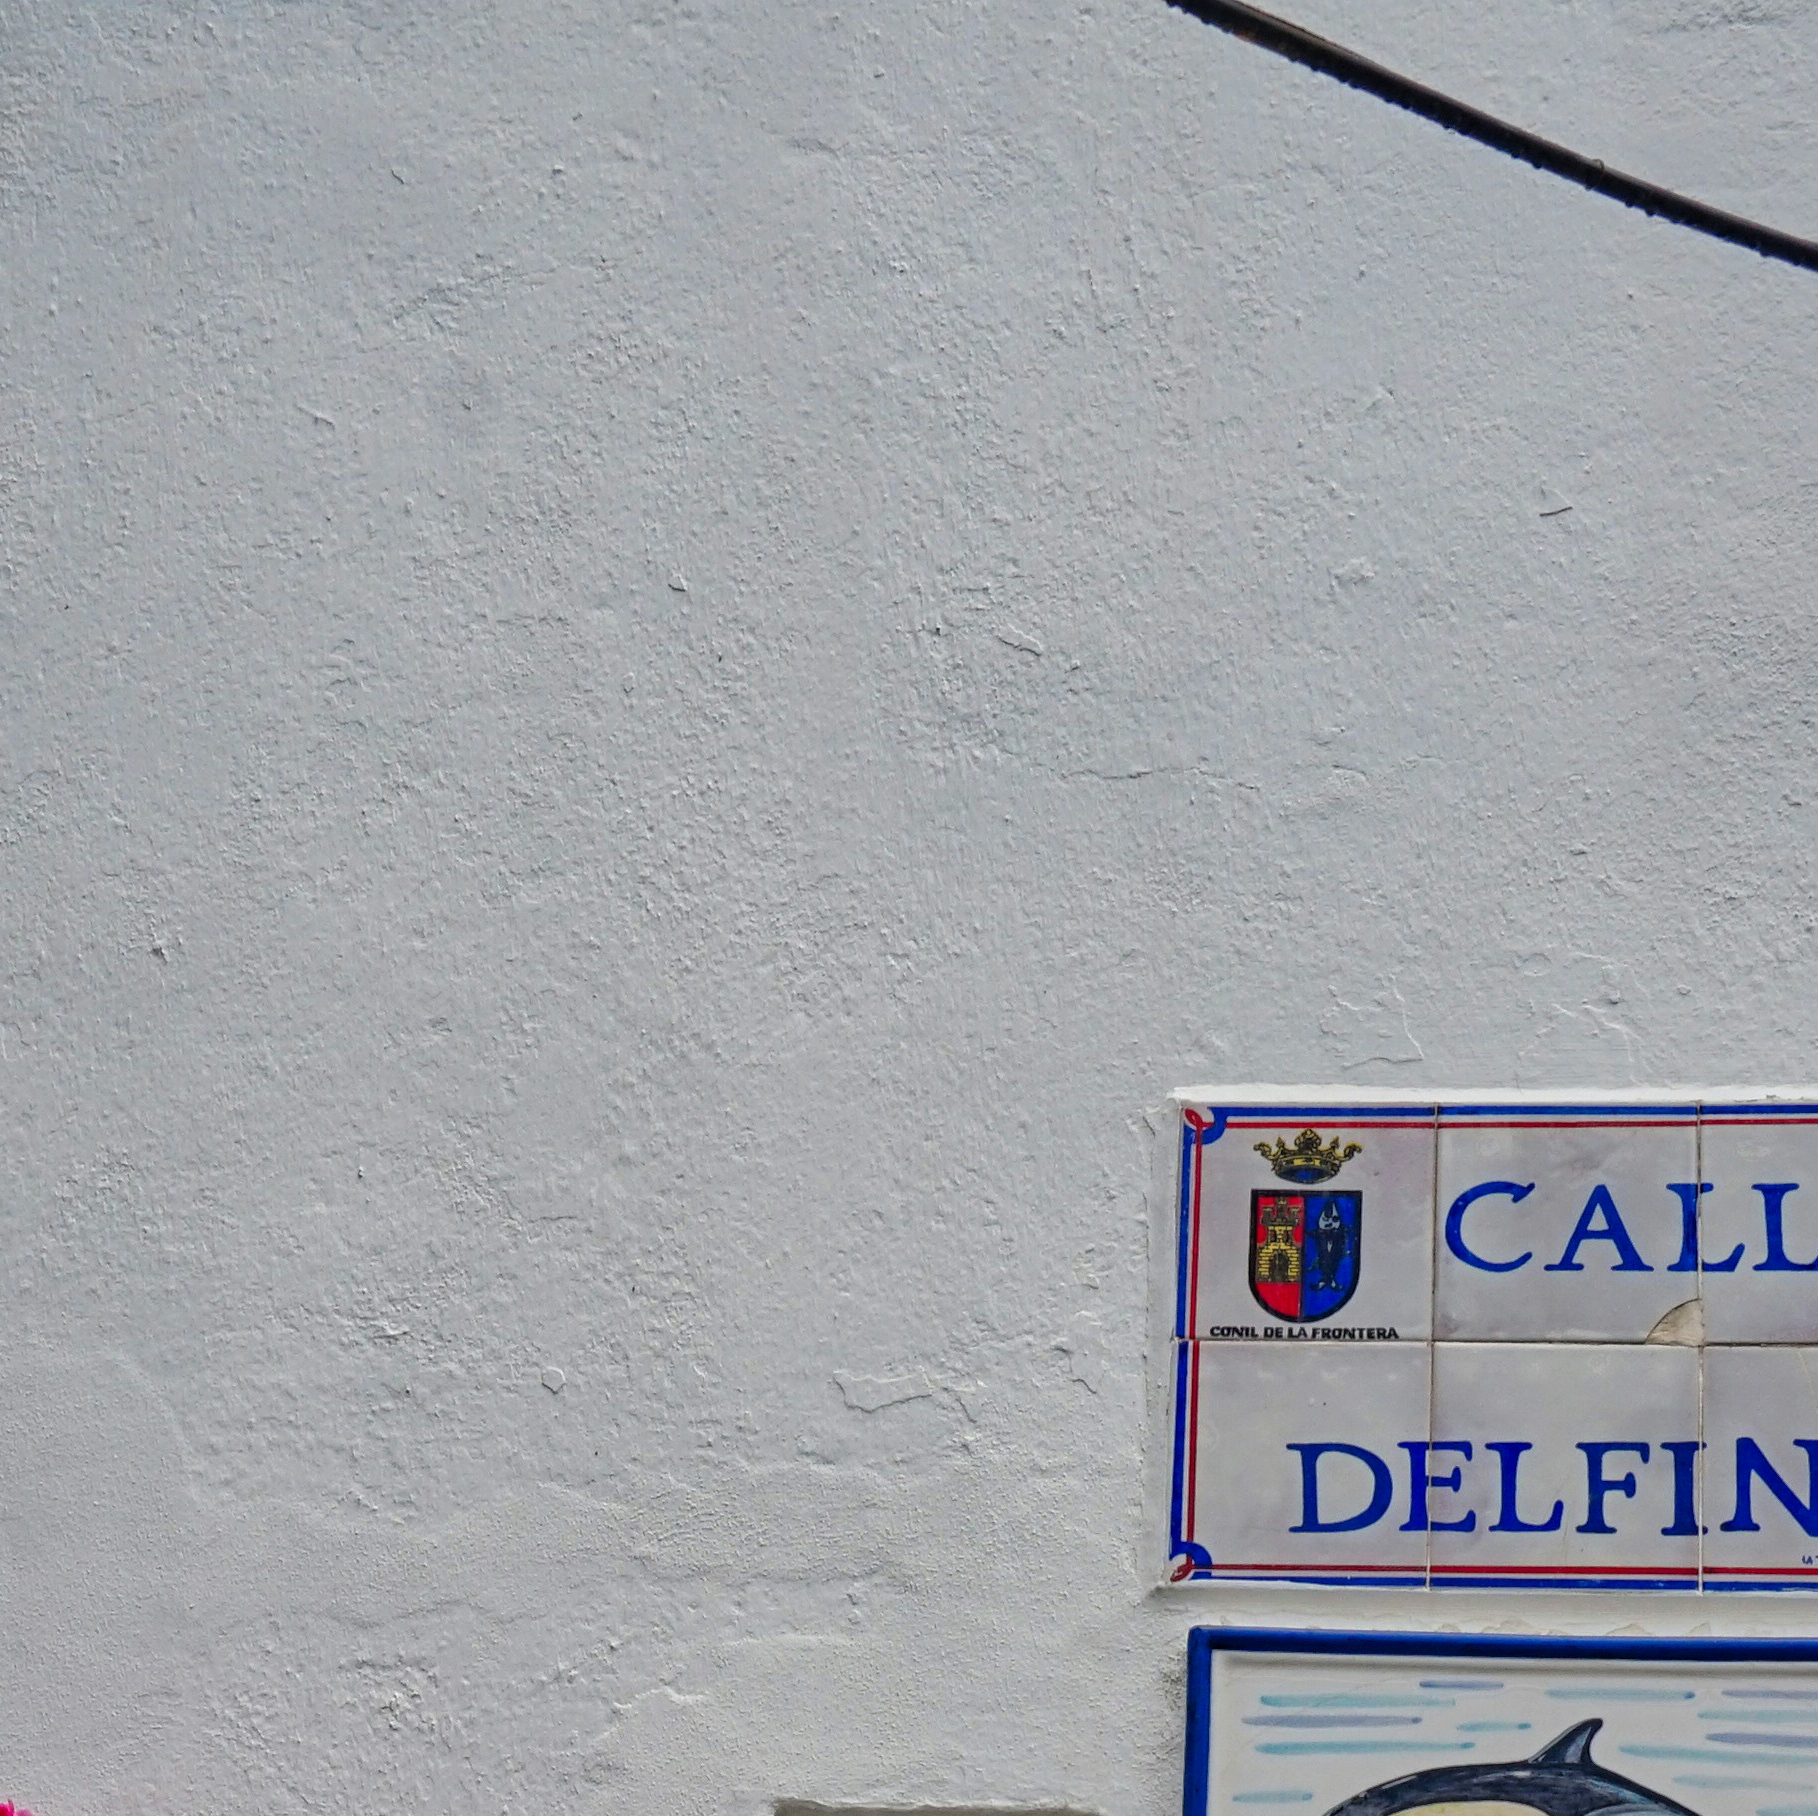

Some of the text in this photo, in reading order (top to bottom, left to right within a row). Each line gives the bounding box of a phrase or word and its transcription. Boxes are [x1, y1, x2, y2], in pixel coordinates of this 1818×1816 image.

[1210, 1326, 1399, 1339] CONIL DE LA FRONTERA
